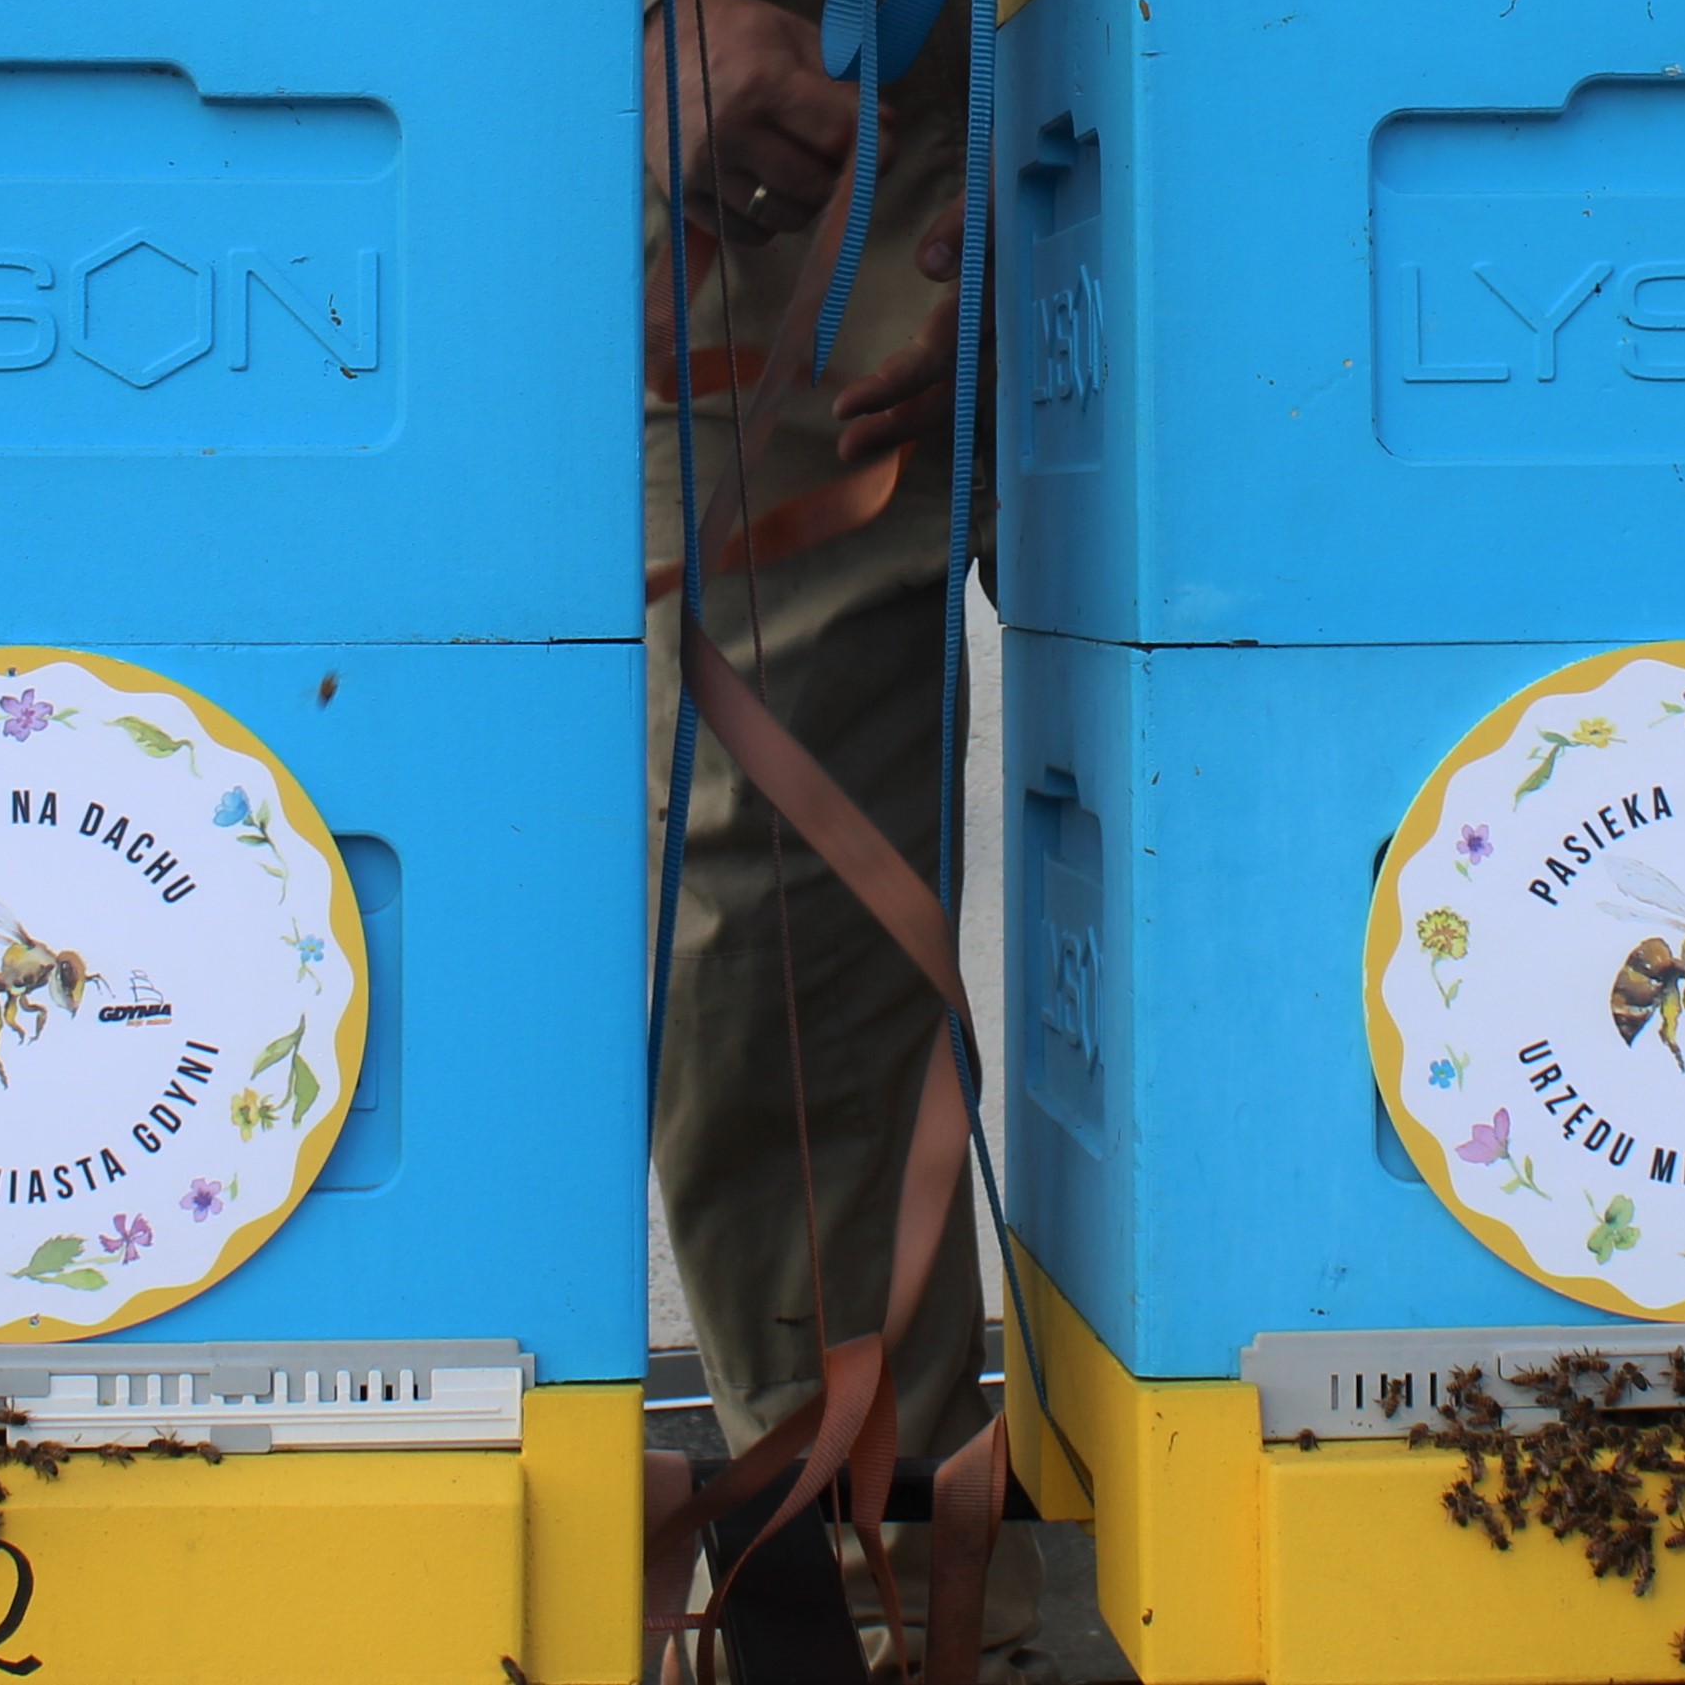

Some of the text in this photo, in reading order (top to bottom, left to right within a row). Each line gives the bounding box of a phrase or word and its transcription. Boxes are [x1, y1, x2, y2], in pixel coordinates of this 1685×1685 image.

[12, 790, 58, 826] NA
[79, 802, 196, 904] DACHU
[1528, 786, 1673, 906] PASIEKA
[132, 1041, 219, 1154] GDYNI
[1518, 1040, 1635, 1167] URZĘDU
